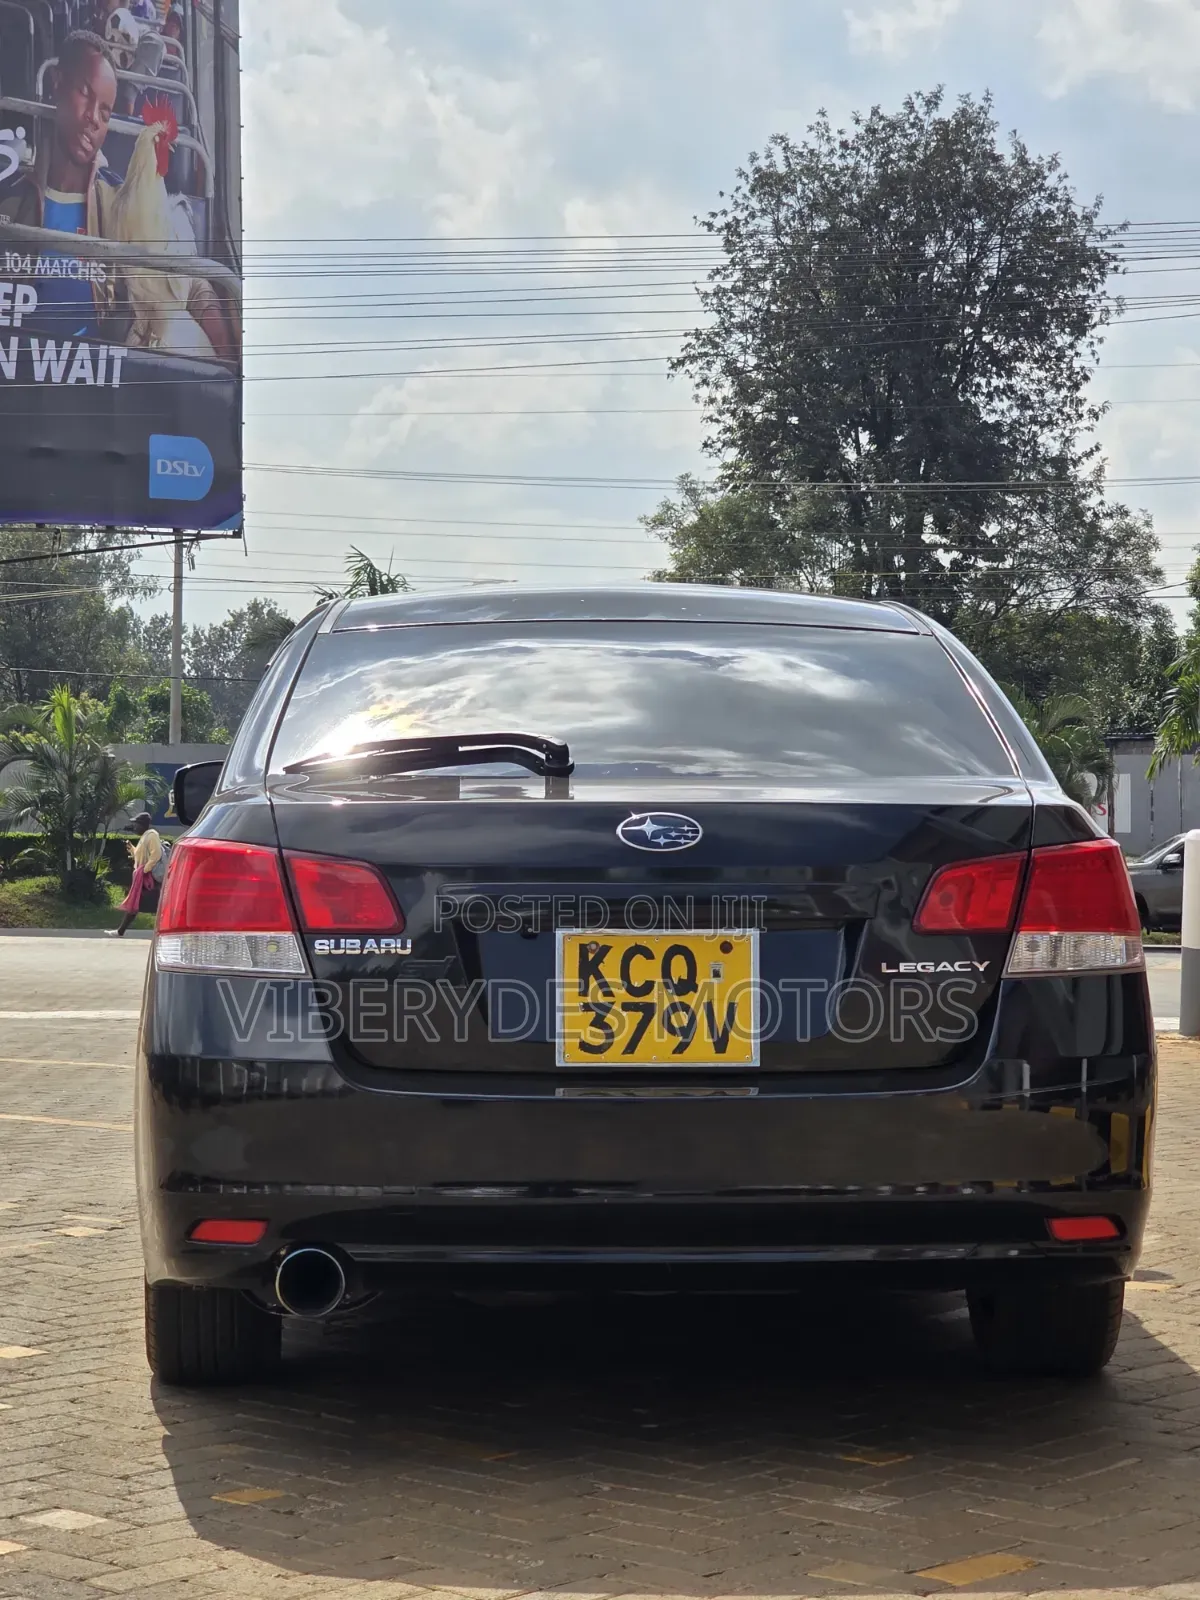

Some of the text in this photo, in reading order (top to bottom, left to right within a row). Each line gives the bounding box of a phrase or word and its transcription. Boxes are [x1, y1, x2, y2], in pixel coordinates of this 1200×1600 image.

[5, 251, 107, 283] 104 MATCHES
[30, 337, 128, 388] WAIT
[157, 459, 206, 477] DStv
[314, 938, 412, 955] SUBARU
[578, 943, 698, 998] KCQ
[881, 960, 991, 973] LEGACY
[578, 1001, 738, 1056] 379V
